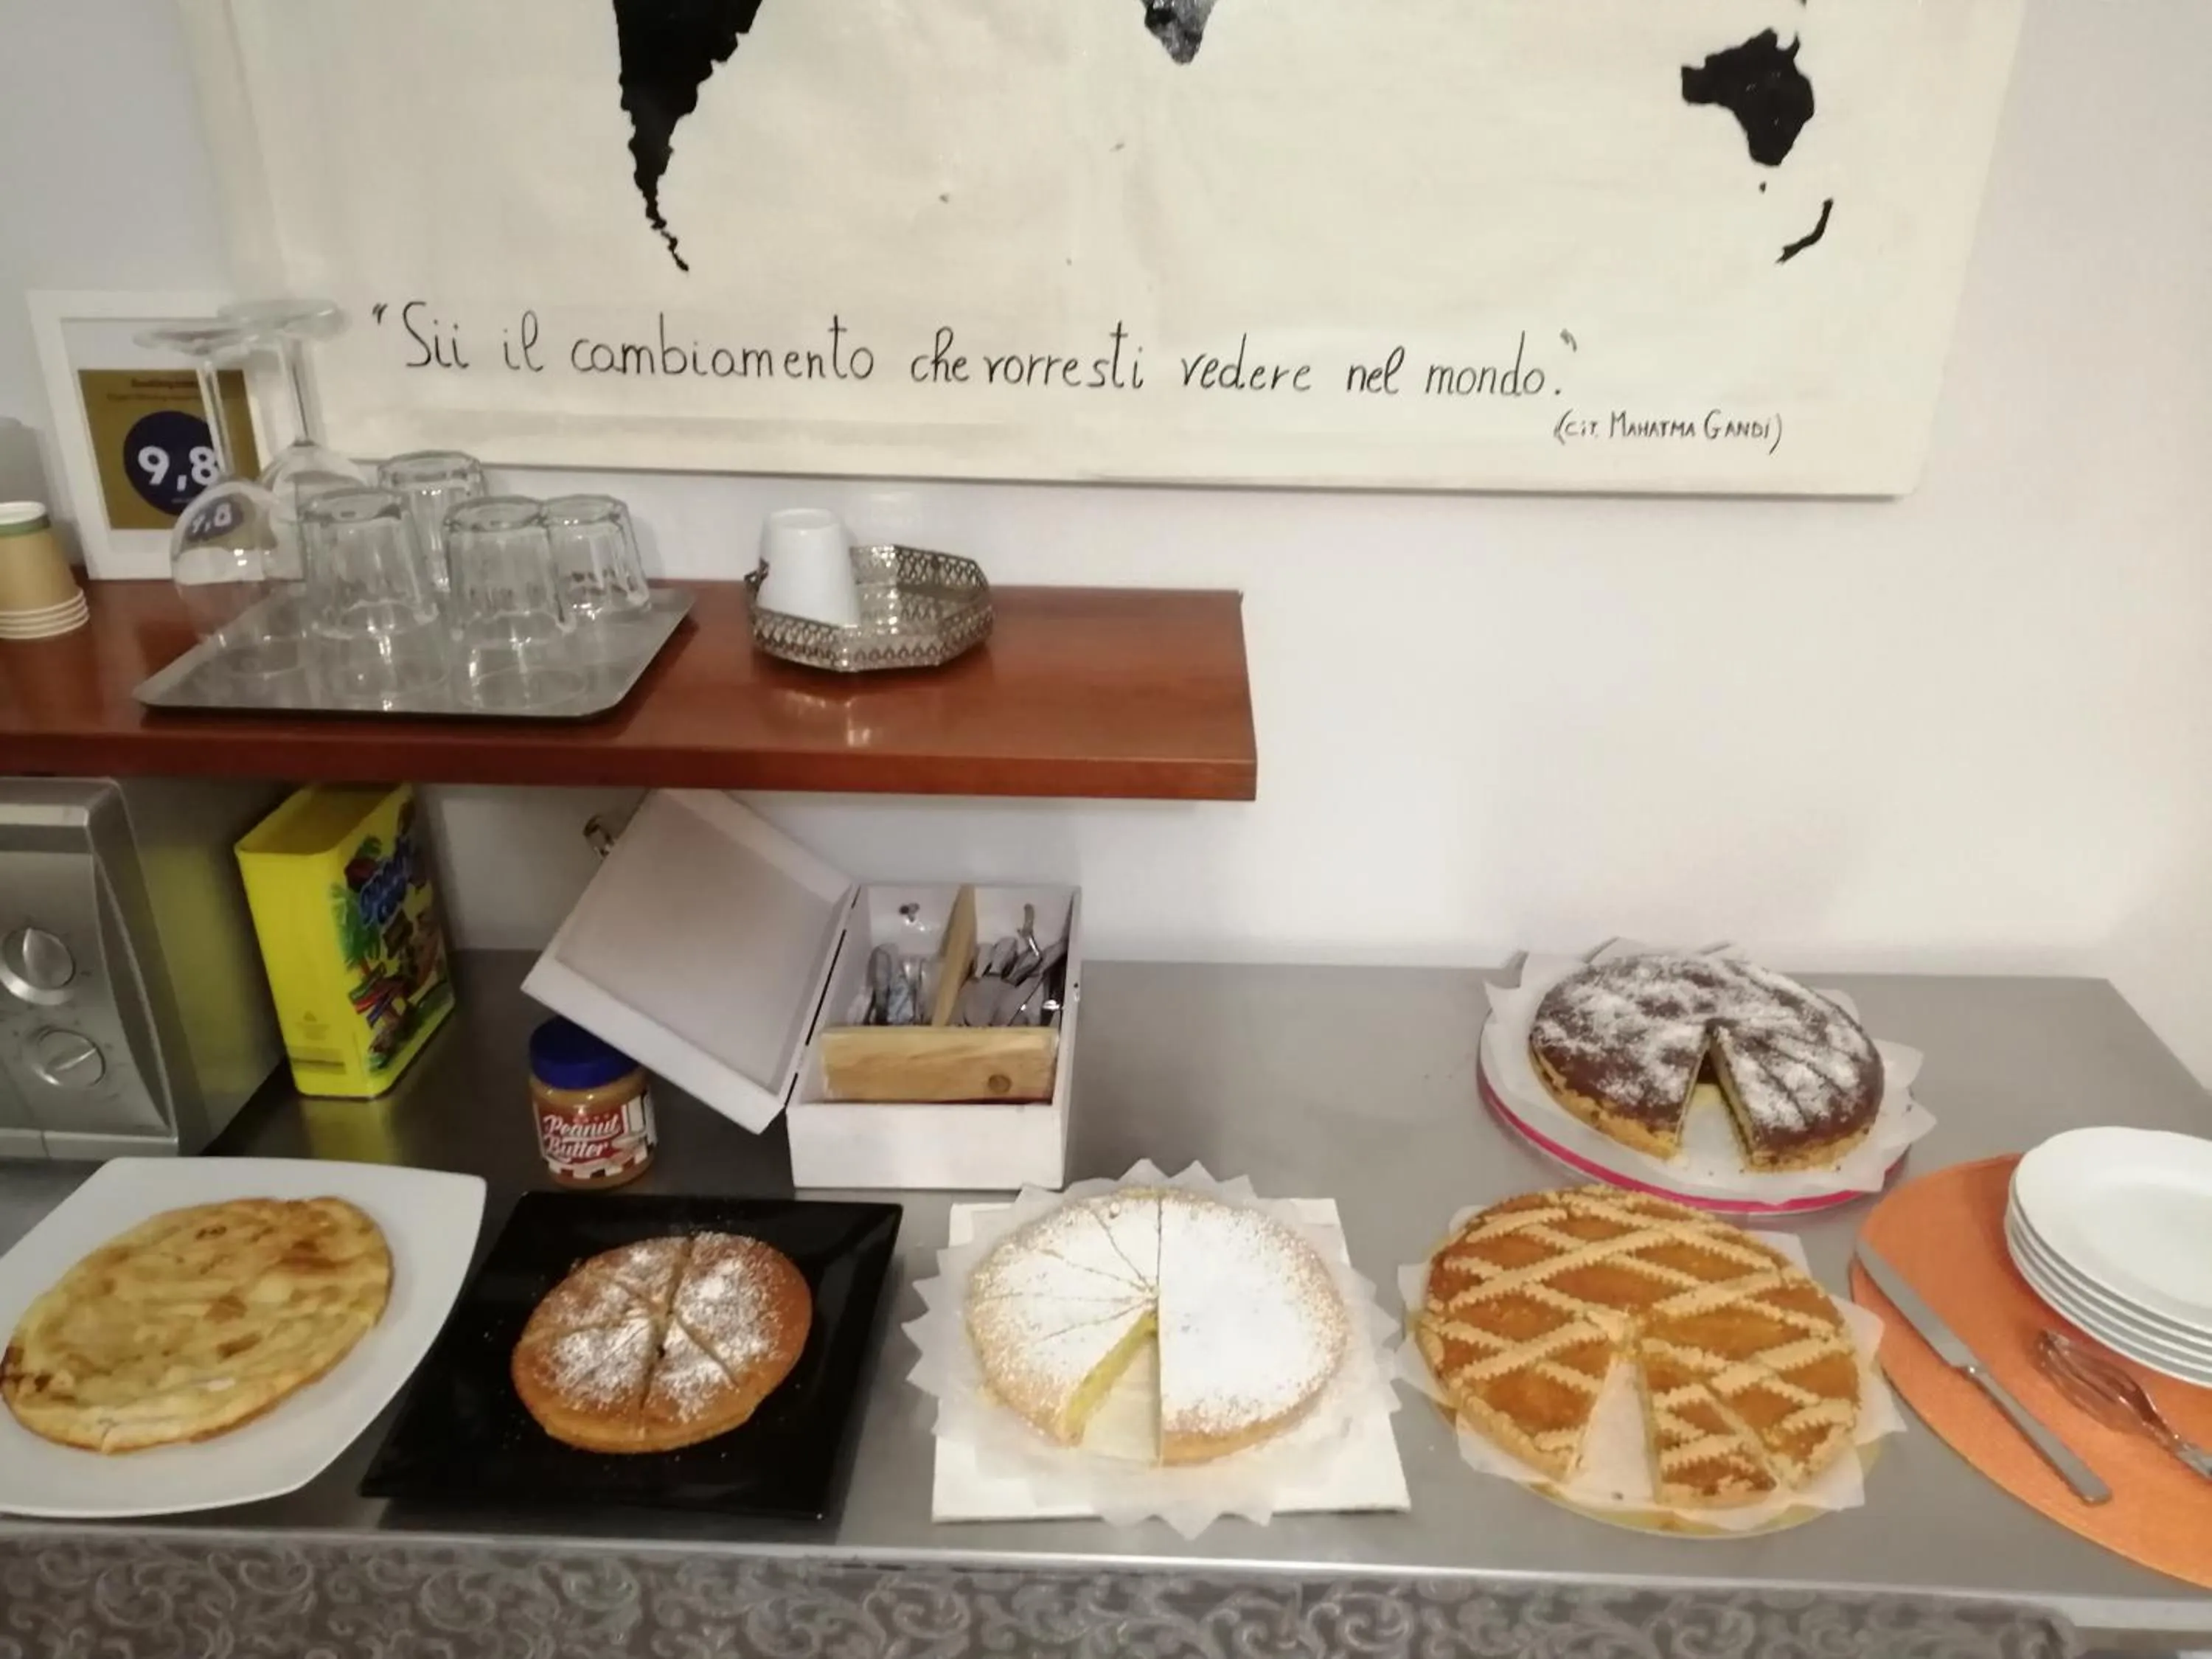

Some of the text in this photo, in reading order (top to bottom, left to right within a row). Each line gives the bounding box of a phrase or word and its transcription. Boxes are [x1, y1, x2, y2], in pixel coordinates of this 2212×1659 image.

[503, 310, 543, 372] il
[571, 312, 874, 379] cambiamento
[911, 326, 970, 383] che
[1346, 346, 1405, 394] nel
[138, 445, 219, 492] 9,8
[542, 1113, 621, 1138] Peanut
[543, 1133, 609, 1163] Butter
